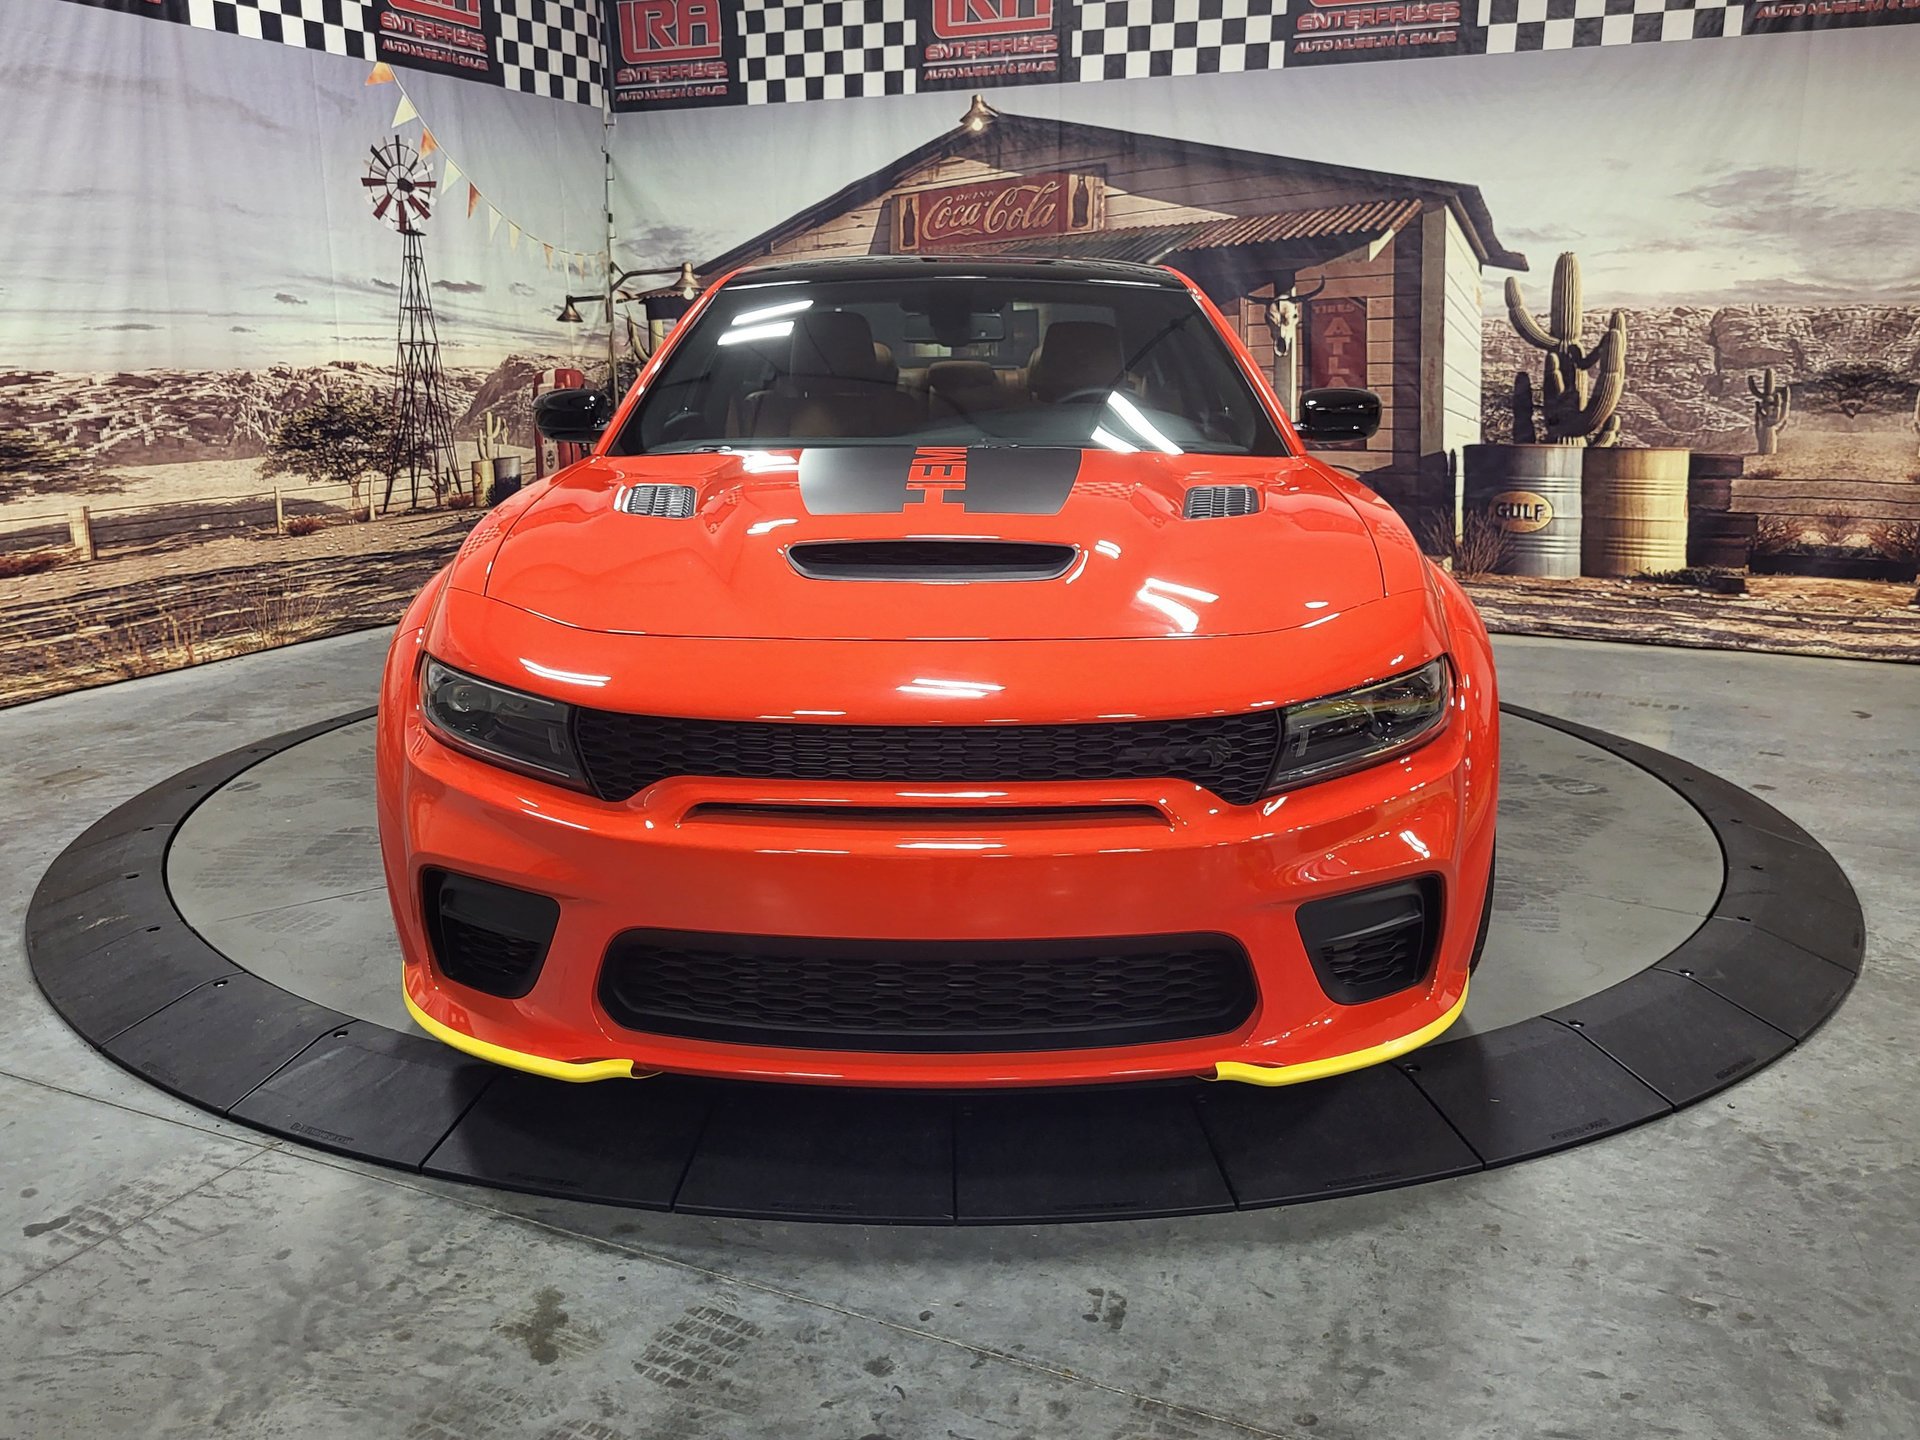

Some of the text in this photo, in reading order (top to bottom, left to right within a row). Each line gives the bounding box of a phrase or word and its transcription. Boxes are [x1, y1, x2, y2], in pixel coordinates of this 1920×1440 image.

[1296, 2, 1461, 31] ENTERPRISES
[1756, 3, 1806, 19] AUTO
[1807, 0, 1884, 15] MUSEUM
[380, 11, 488, 51] ENTERPRISES
[1294, 39, 1334, 53] AUTO
[1335, 35, 1396, 50] MUSEUM
[1409, 31, 1457, 45] SALES
[382, 39, 410, 54] AUTO
[925, 34, 1058, 60] ENTERPRISES
[616, 61, 728, 83] ENTERPRISES
[924, 67, 957, 80] AUTO
[1017, 61, 1057, 73] SALES
[616, 91, 645, 102] AUTO
[903, 446, 968, 514] HEM
[1496, 502, 1545, 522] GULF
